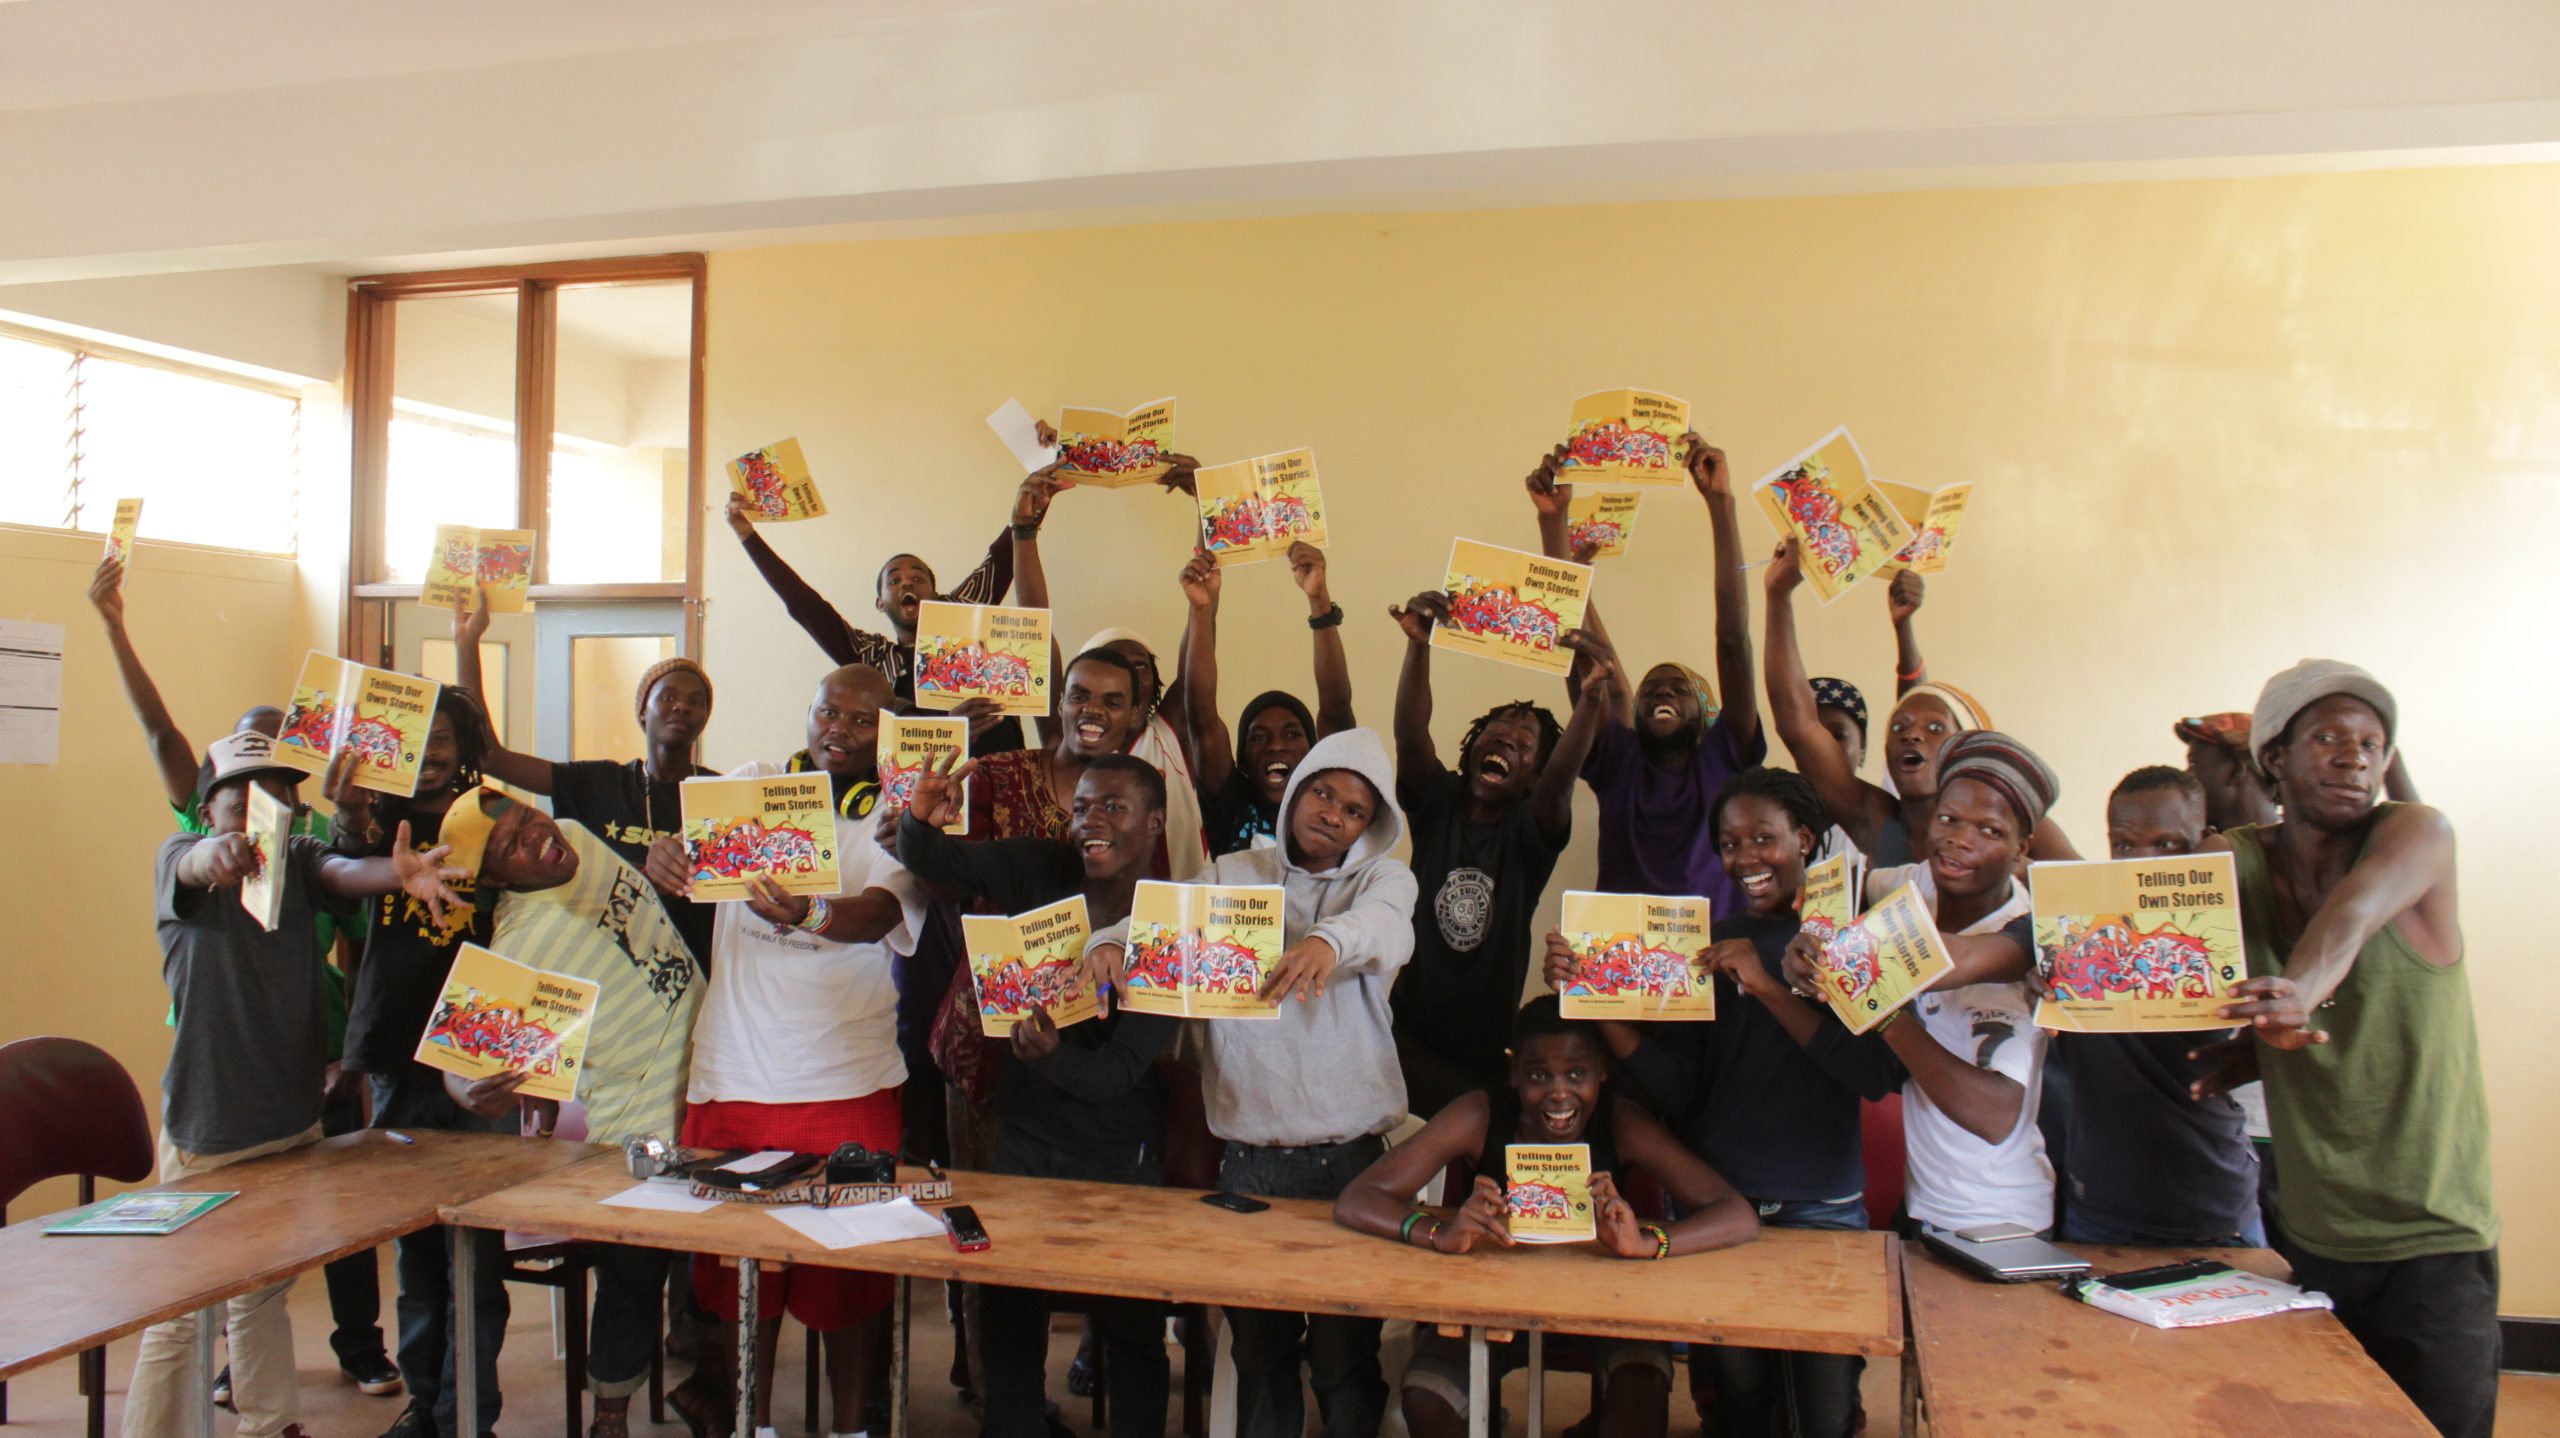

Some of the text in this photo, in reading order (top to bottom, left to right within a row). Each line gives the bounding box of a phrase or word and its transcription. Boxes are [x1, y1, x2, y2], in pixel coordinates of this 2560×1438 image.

[1152, 408, 1166, 420] Our
[1142, 417, 1168, 429] Stories
[1288, 458, 1302, 468] Our
[1280, 470, 1310, 482] Stories
[1529, 563, 1578, 583] Telling Our
[1525, 577, 1580, 598] Own Stories
[992, 615, 1038, 627] Telling Our
[990, 628, 1042, 640] Own Stories
[370, 678, 424, 698] Telling Our
[366, 692, 424, 714] Own Stories
[900, 728, 953, 739] Telling Our
[900, 742, 921, 752] Own
[762, 784, 816, 798] Telling Our
[764, 800, 824, 812] Own Stories
[2136, 870, 2214, 888] Telling Our
[1210, 896, 1268, 910] Telling Our
[2138, 891, 2224, 909] Own Stories
[1210, 912, 1274, 926] Own Stories
[1648, 906, 1696, 918] Telling Our
[1020, 910, 1072, 936] Telling Our
[1648, 920, 1701, 934] Own Stories
[1896, 896, 1932, 961] Telling Our
[1024, 924, 1081, 951] Own Stories
[1881, 907, 1920, 978] Own Stories
[536, 981, 584, 1002] Telling Our
[531, 996, 548, 1010] Own
[1516, 1152, 1574, 1161] Telling Our
[1516, 1163, 1580, 1172] Own Stories
